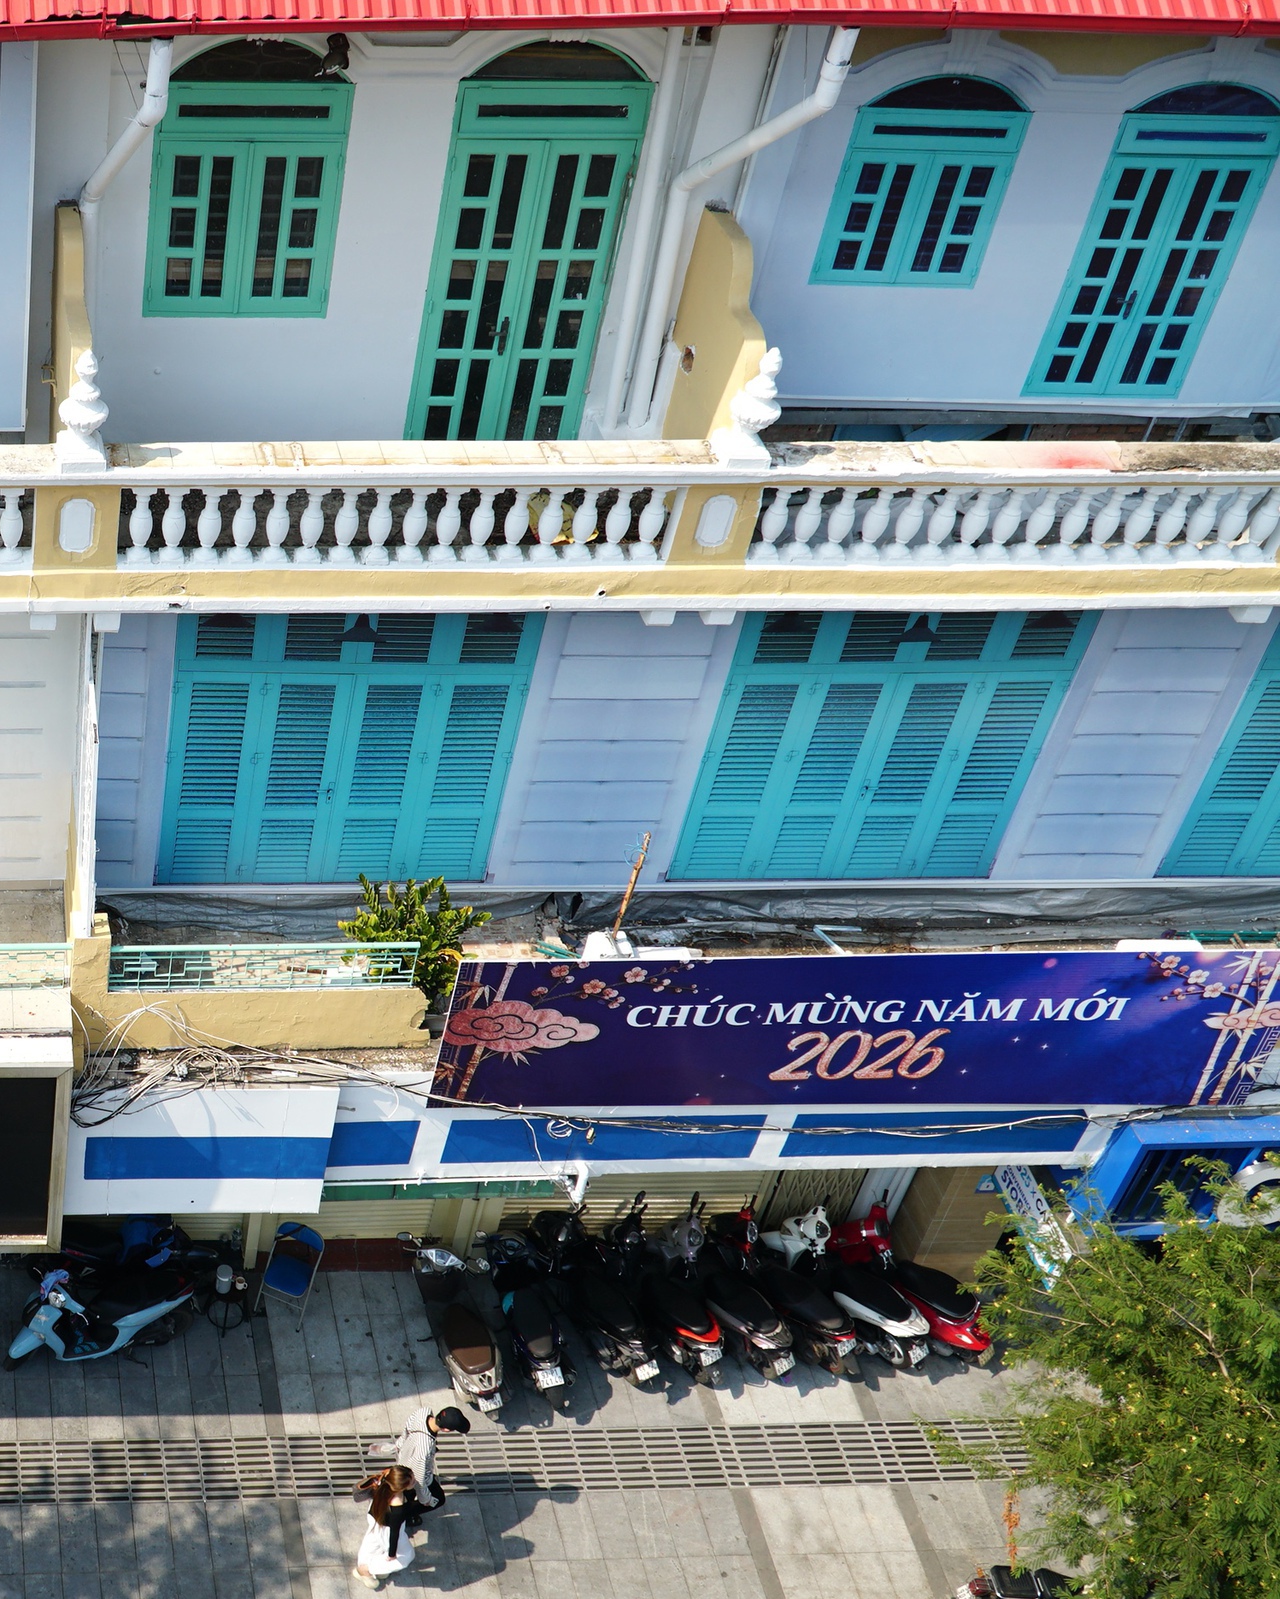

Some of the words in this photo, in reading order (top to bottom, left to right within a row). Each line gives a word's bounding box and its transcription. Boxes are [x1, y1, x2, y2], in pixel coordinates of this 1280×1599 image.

[626, 995, 758, 1028] CHÚC
[762, 993, 906, 1026] MỪNG
[916, 991, 1026, 1024] NĂM
[1030, 988, 1132, 1022] MỚI
[769, 1028, 952, 1081] 2026
